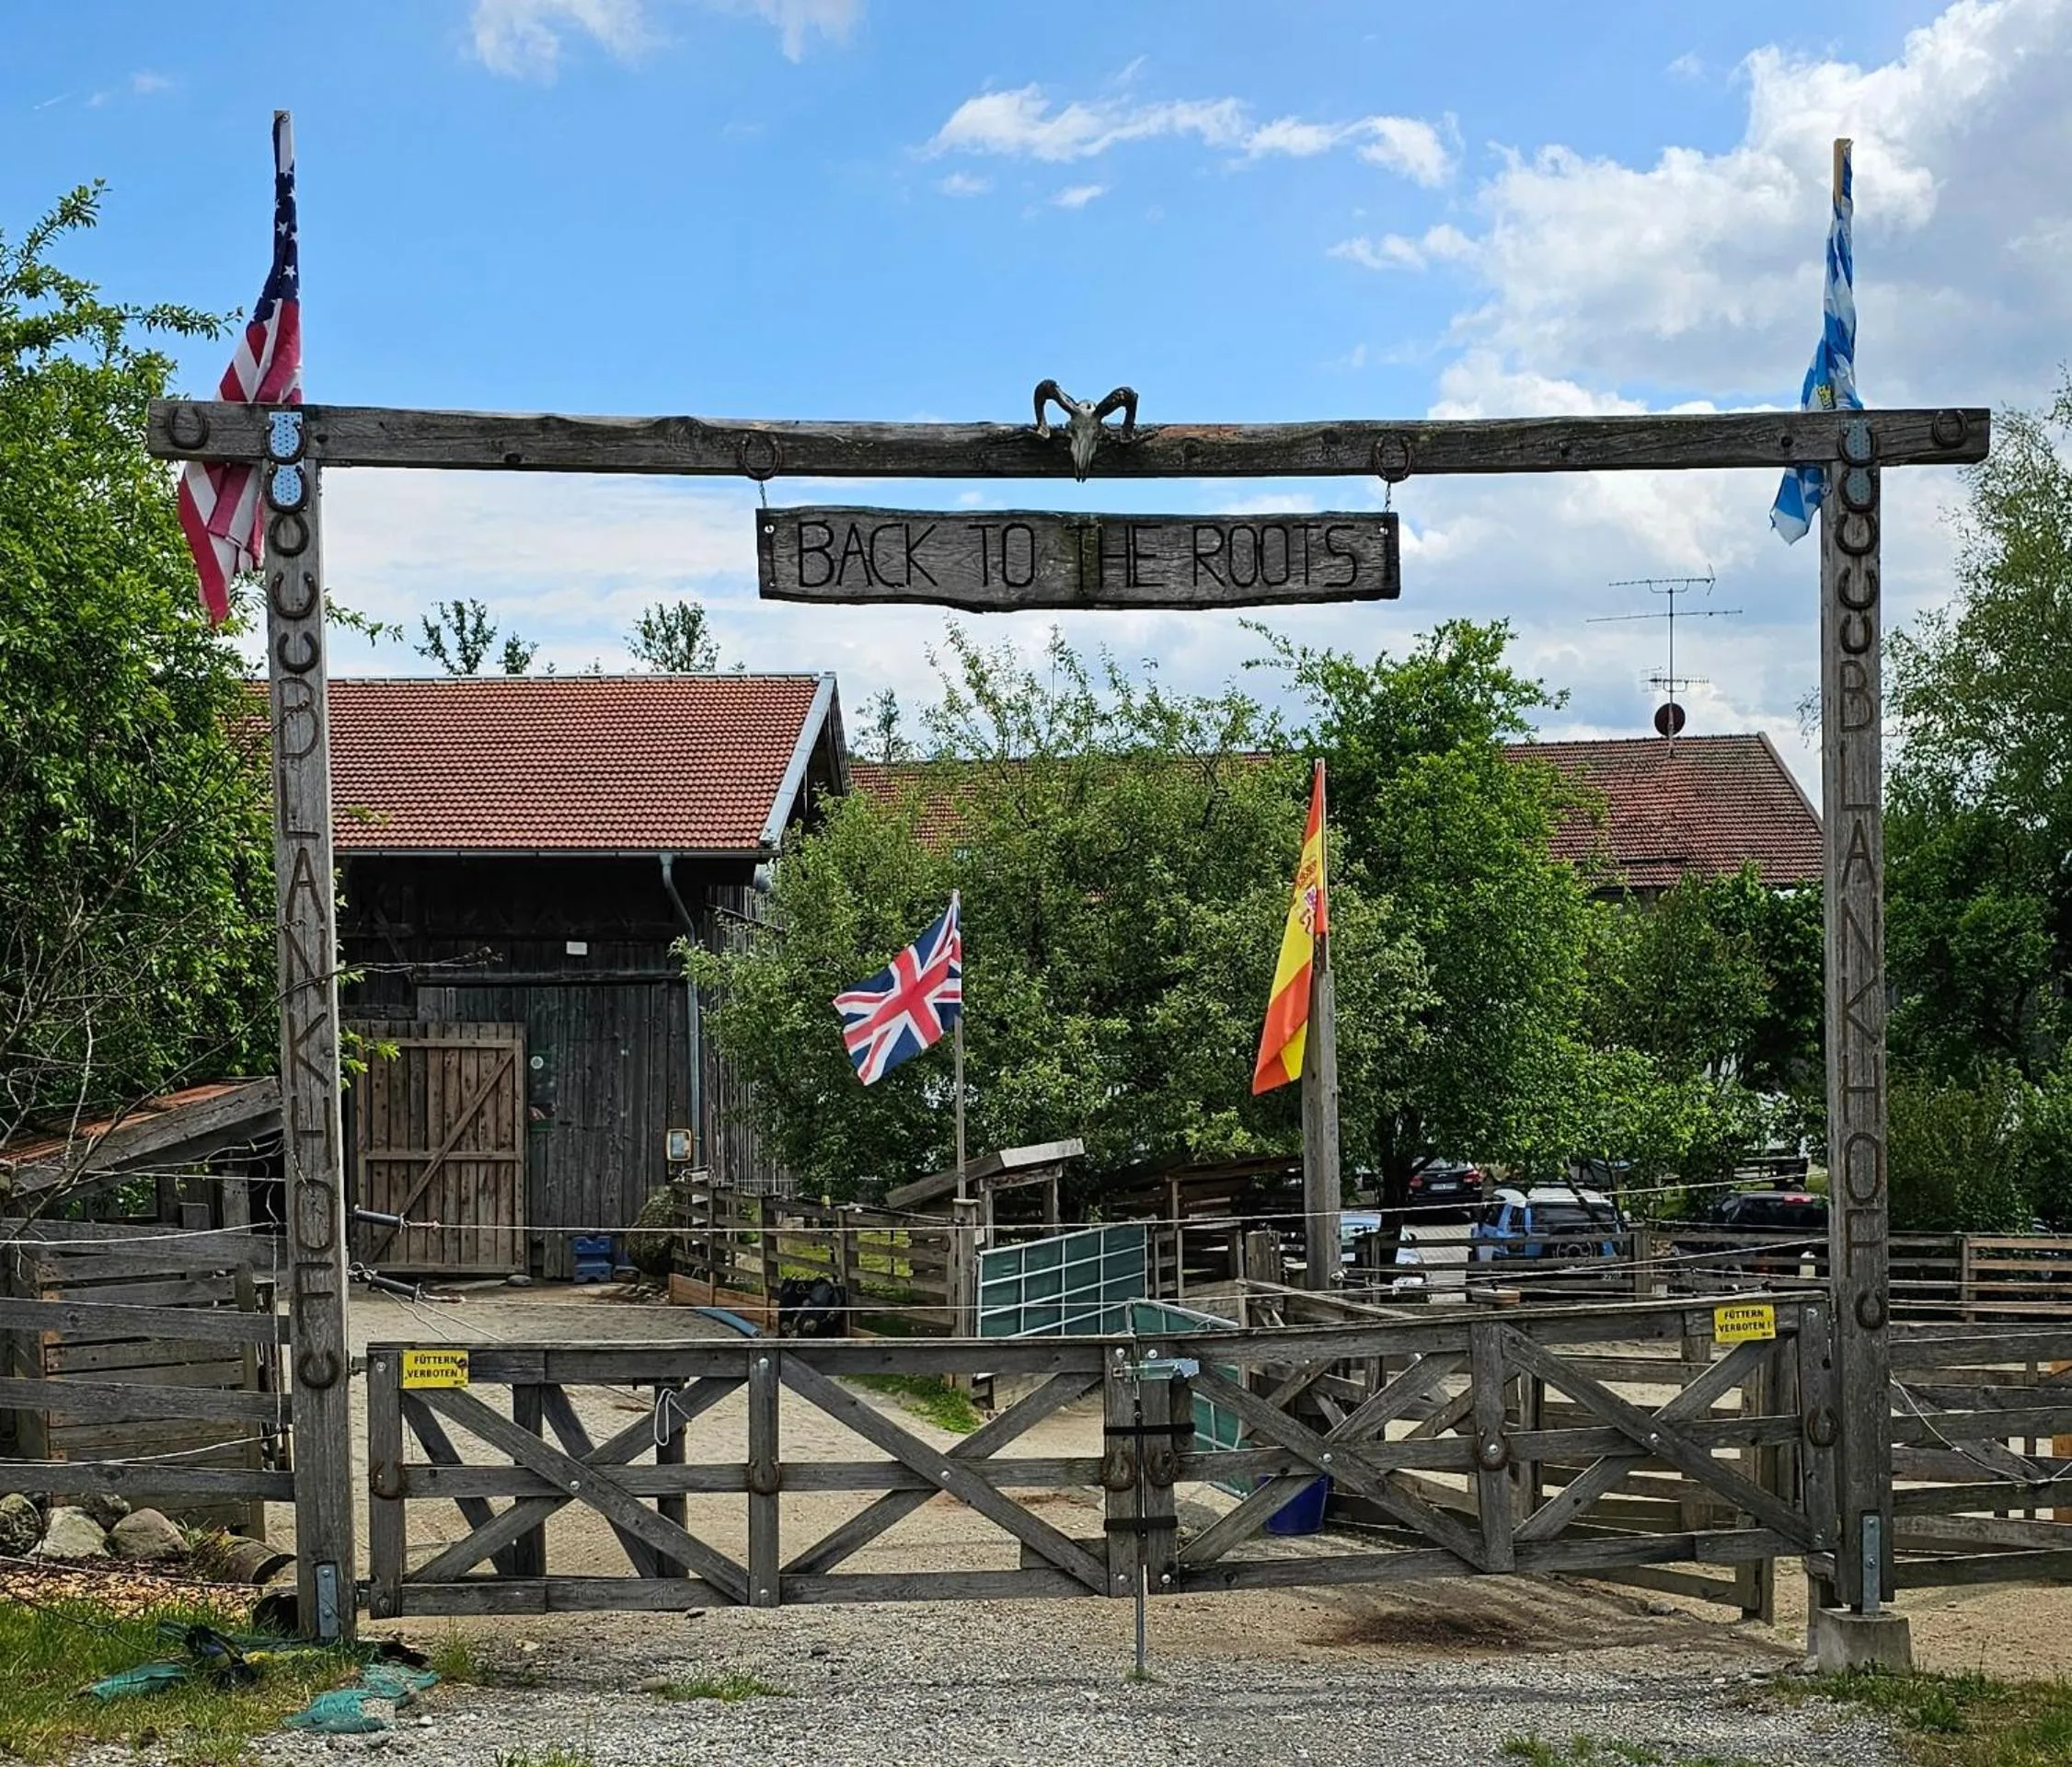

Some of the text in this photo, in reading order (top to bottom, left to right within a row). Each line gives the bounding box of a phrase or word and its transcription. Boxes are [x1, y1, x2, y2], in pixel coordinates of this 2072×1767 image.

[797, 520, 1358, 595] BACK TO THE ROOTS
[278, 676, 334, 1336] BLANKHOF
[1840, 660, 1883, 1278] BLANKHOF
[1724, 1309, 1765, 1320] FÜTTERN
